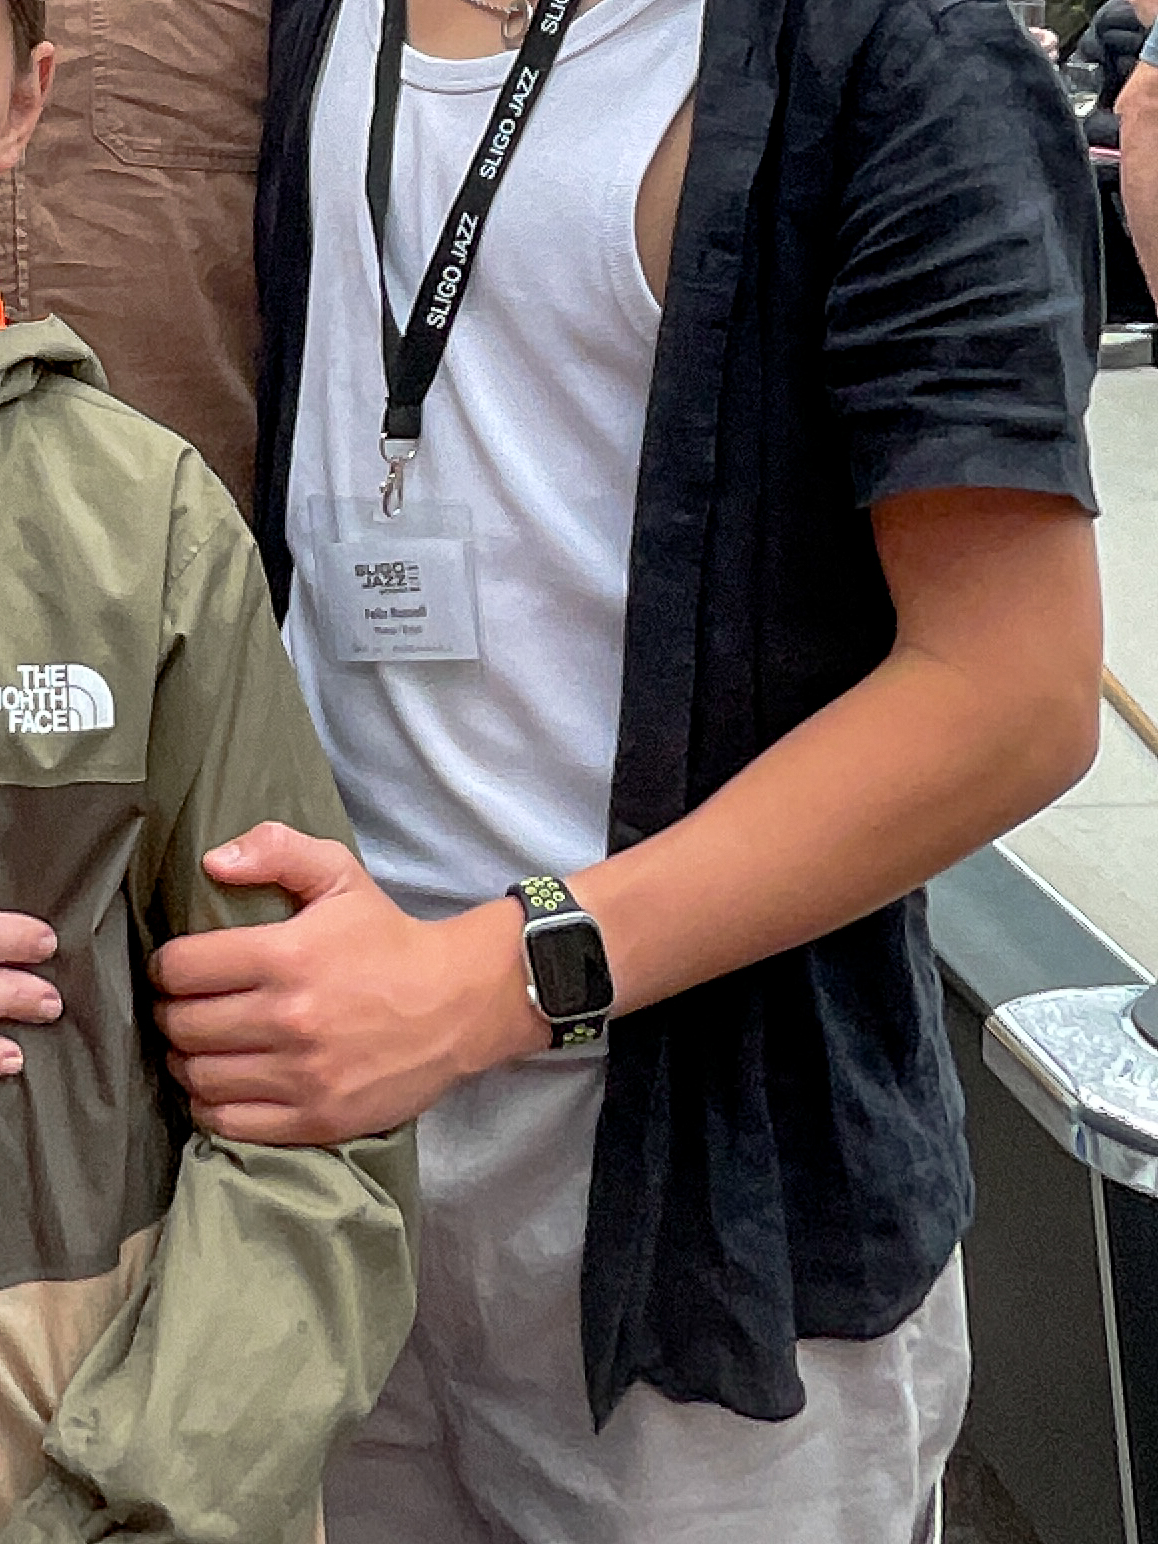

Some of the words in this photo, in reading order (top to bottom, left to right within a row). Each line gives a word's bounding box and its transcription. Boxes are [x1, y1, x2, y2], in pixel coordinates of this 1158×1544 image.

[478, 118, 517, 180] SLIGO
[508, 65, 540, 118] JAZZ
[426, 264, 462, 330] SLIGO
[450, 212, 479, 266] JAZZ
[16, 664, 68, 688] THE
[7, 709, 69, 734] FACE
